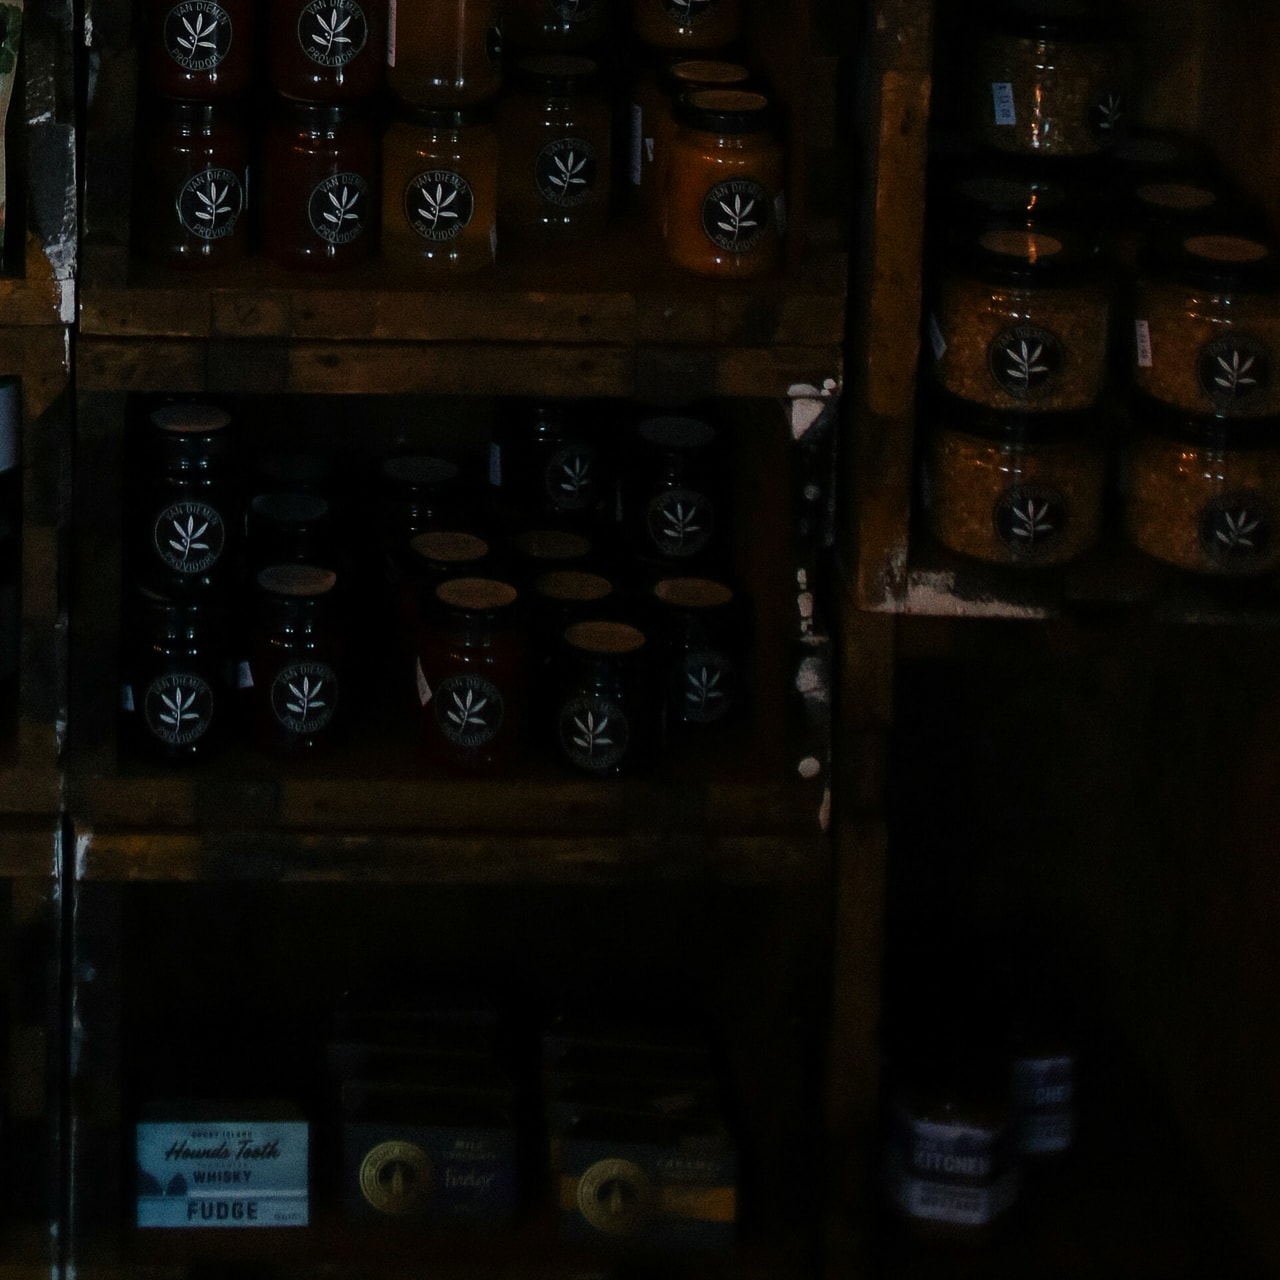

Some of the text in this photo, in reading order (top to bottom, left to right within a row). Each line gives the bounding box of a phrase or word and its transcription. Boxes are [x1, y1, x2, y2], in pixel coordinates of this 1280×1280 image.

[173, 1, 228, 26] VAN DIEMEN
[171, 47, 222, 70] PROVIDORE
[306, 45, 357, 66] PROVIDORE
[186, 174, 205, 193] VAN
[319, 176, 340, 193] VAN
[414, 220, 464, 241] PROVIDORE
[165, 1140, 280, 1161] Hounds Tooth
[193, 1170, 252, 1184] WHISKY
[187, 1200, 259, 1221] FUDGE
